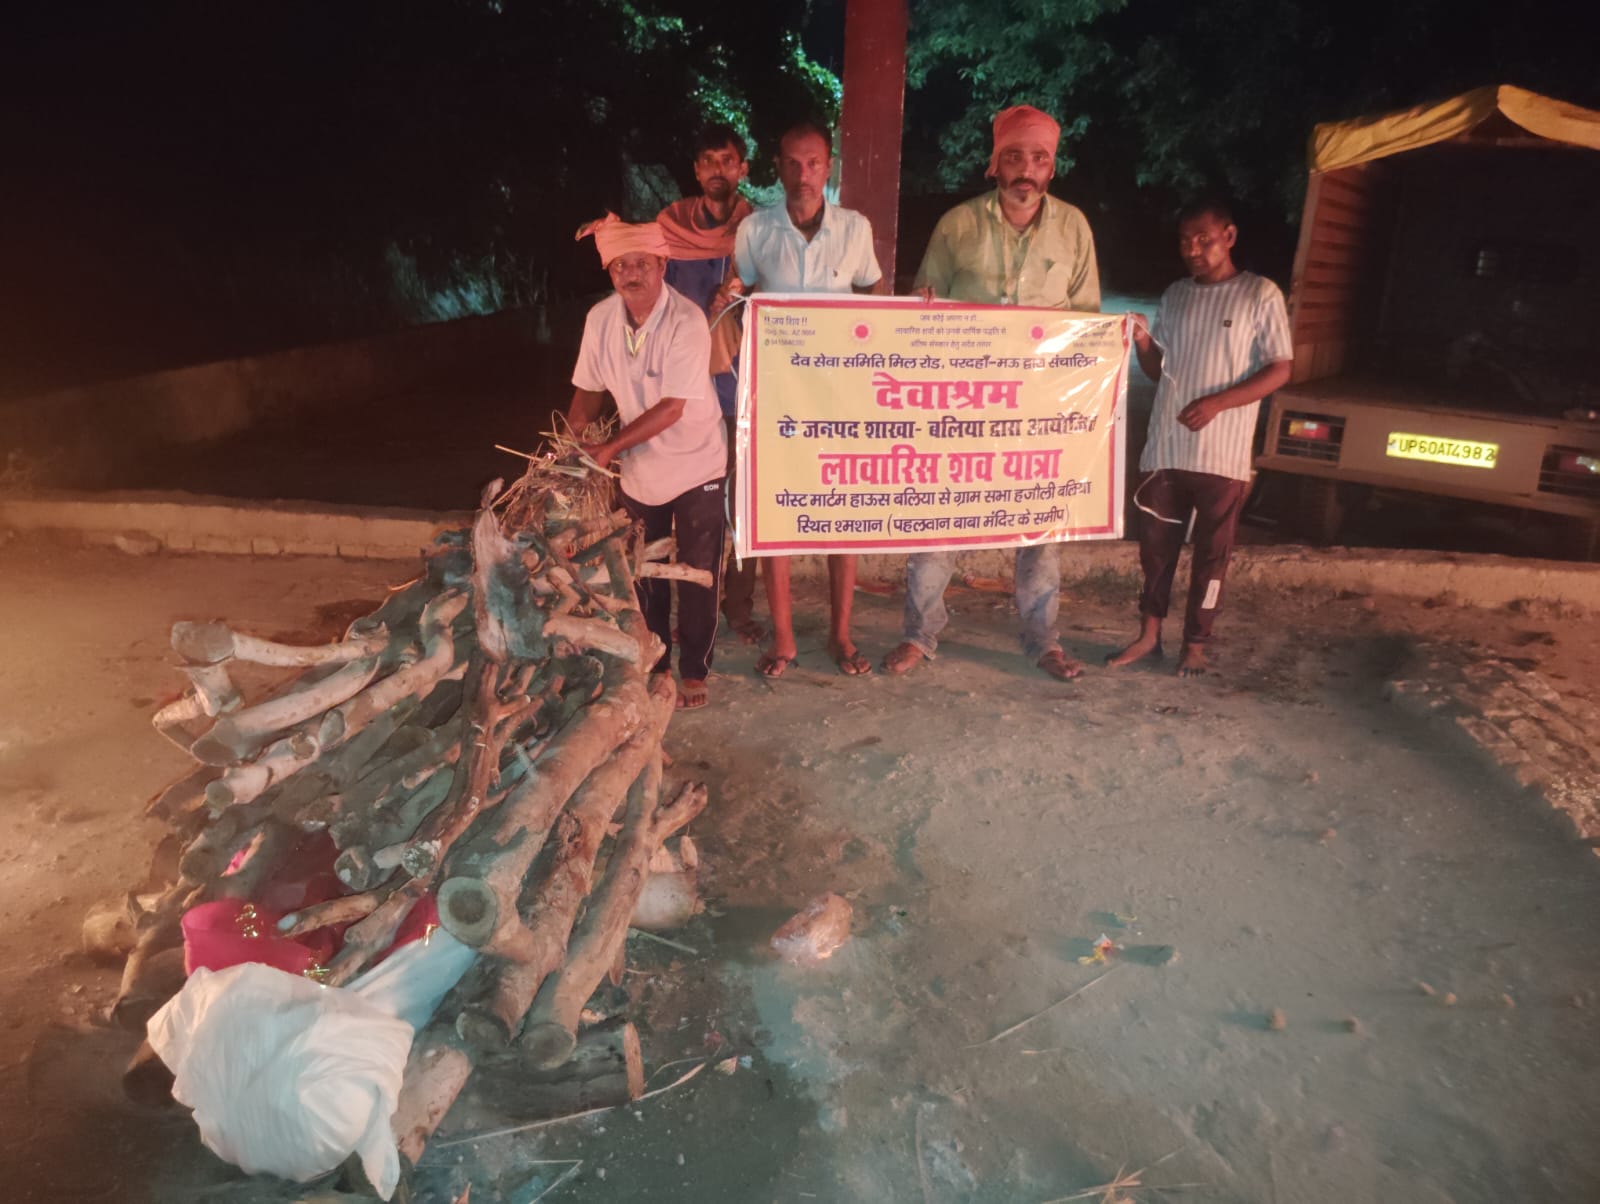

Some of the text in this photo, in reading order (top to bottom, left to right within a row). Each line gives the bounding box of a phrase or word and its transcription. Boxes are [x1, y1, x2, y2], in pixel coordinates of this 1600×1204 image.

[791, 352, 810, 367] देव
[814, 353, 840, 367] सेवा
[843, 352, 886, 369] समिति
[888, 353, 917, 369] मिल
[919, 355, 945, 370] रोड,
[1048, 352, 1099, 368] संचालित
[872, 371, 1023, 410] देवाश्रम
[777, 414, 798, 439] के
[801, 420, 860, 439] जनपद
[928, 415, 986, 439] बलिया
[989, 418, 1023, 438] द्वारा
[818, 444, 1063, 486] लावारिस शव यात्रा
[775, 488, 808, 508] पोस्ट
[810, 488, 847, 508] मार्टम
[850, 491, 890, 508] हाऊस
[893, 487, 935, 507] बलिया
[938, 487, 950, 505] से
[953, 490, 981, 507] ग्राम
[984, 489, 1011, 504] सभा
[797, 503, 1069, 536] स्थित श्मशान (पहलवान बाबा मंदिर के समीप)
